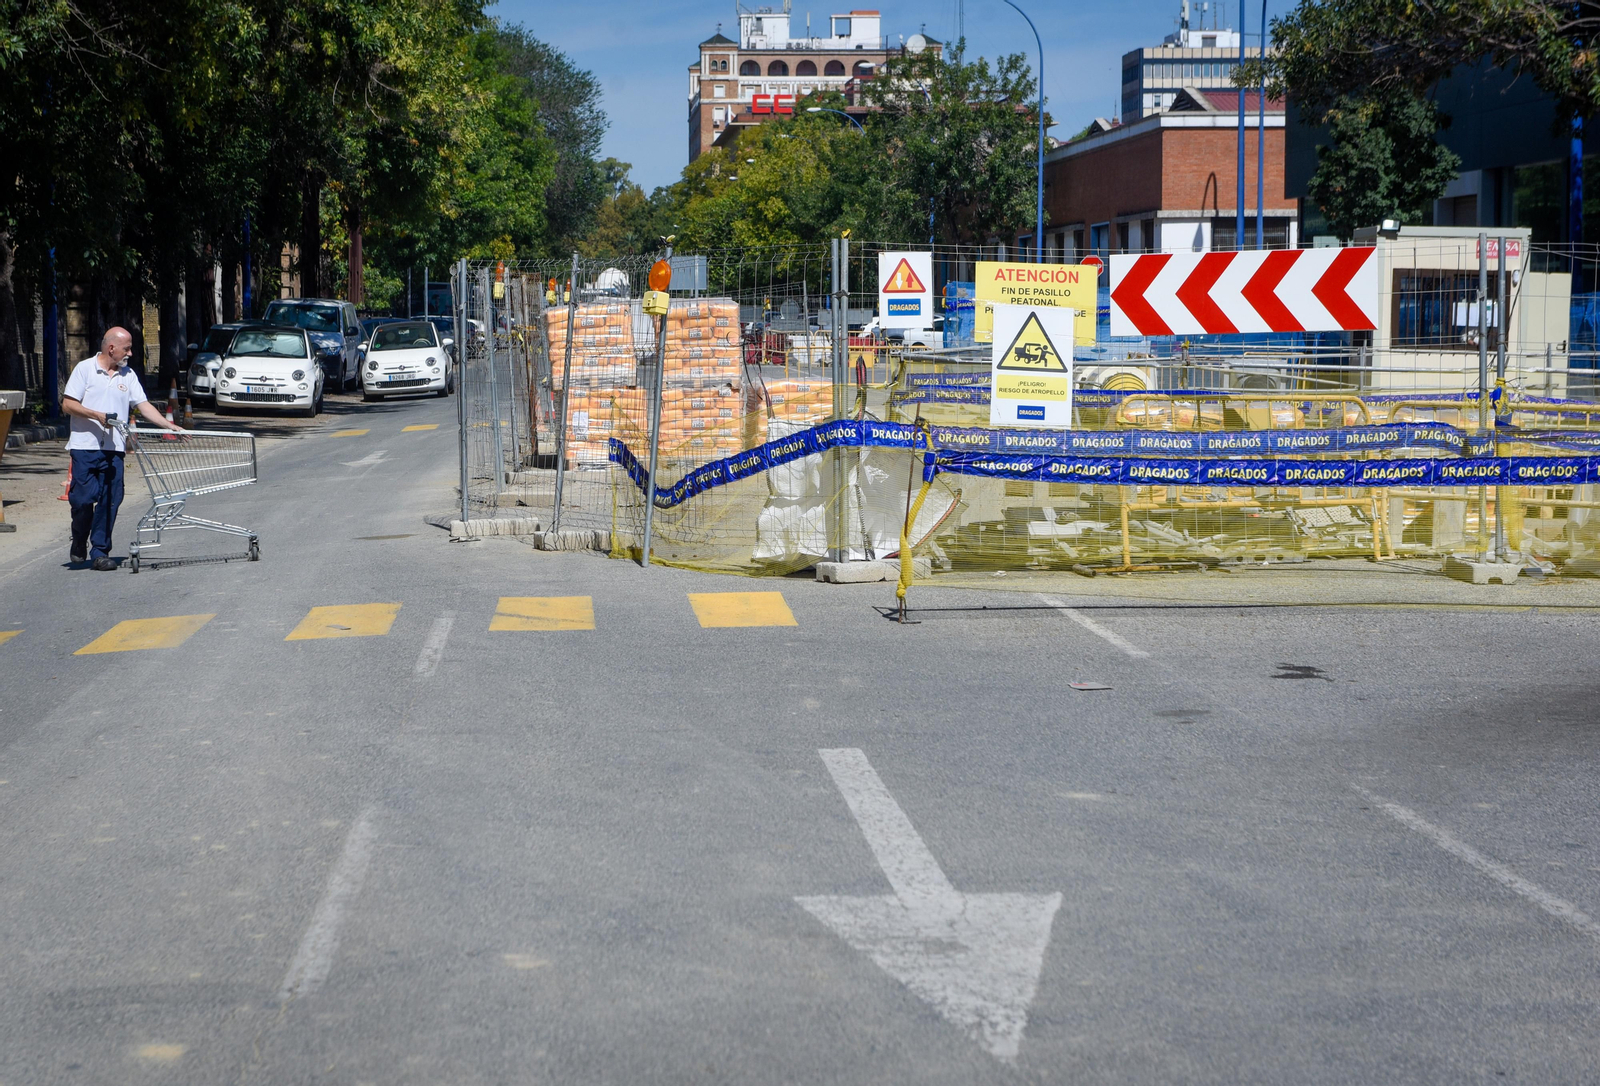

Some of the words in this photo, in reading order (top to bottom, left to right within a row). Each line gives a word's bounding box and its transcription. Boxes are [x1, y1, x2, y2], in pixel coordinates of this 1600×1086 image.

[994, 267, 1079, 284] ATENCIÓN
[1001, 287, 1015, 295] FIN
[1033, 288, 1071, 297] PASILLO
[889, 303, 920, 311] DRAGADOS
[1010, 297, 1061, 306] PEATONAL.
[816, 428, 857, 443] DRAGADOS
[871, 428, 923, 441] DRAGADOS
[938, 432, 990, 445] DRAGADOS
[1005, 435, 1057, 447] DRAGADOS
[1073, 436, 1125, 448] DRAGADOS
[1140, 437, 1193, 449] DRAGADOS
[1208, 437, 1261, 449] DRAGADOS
[1277, 435, 1330, 447] DRAGADOS
[1346, 431, 1399, 444] DRAGADOS
[1414, 430, 1465, 448] DRAGADOS
[972, 460, 1034, 473] DRAGADOS
[1051, 462, 1112, 476] DRAGADOS
[1129, 466, 1190, 479] DRAGADOS
[1207, 467, 1268, 480] DRAGADOS
[1286, 468, 1346, 480] DRAGADOS
[1363, 466, 1424, 479] DRAGADOS
[1442, 465, 1501, 478] DRAGADOS
[1519, 465, 1579, 478] DRAGADOS
